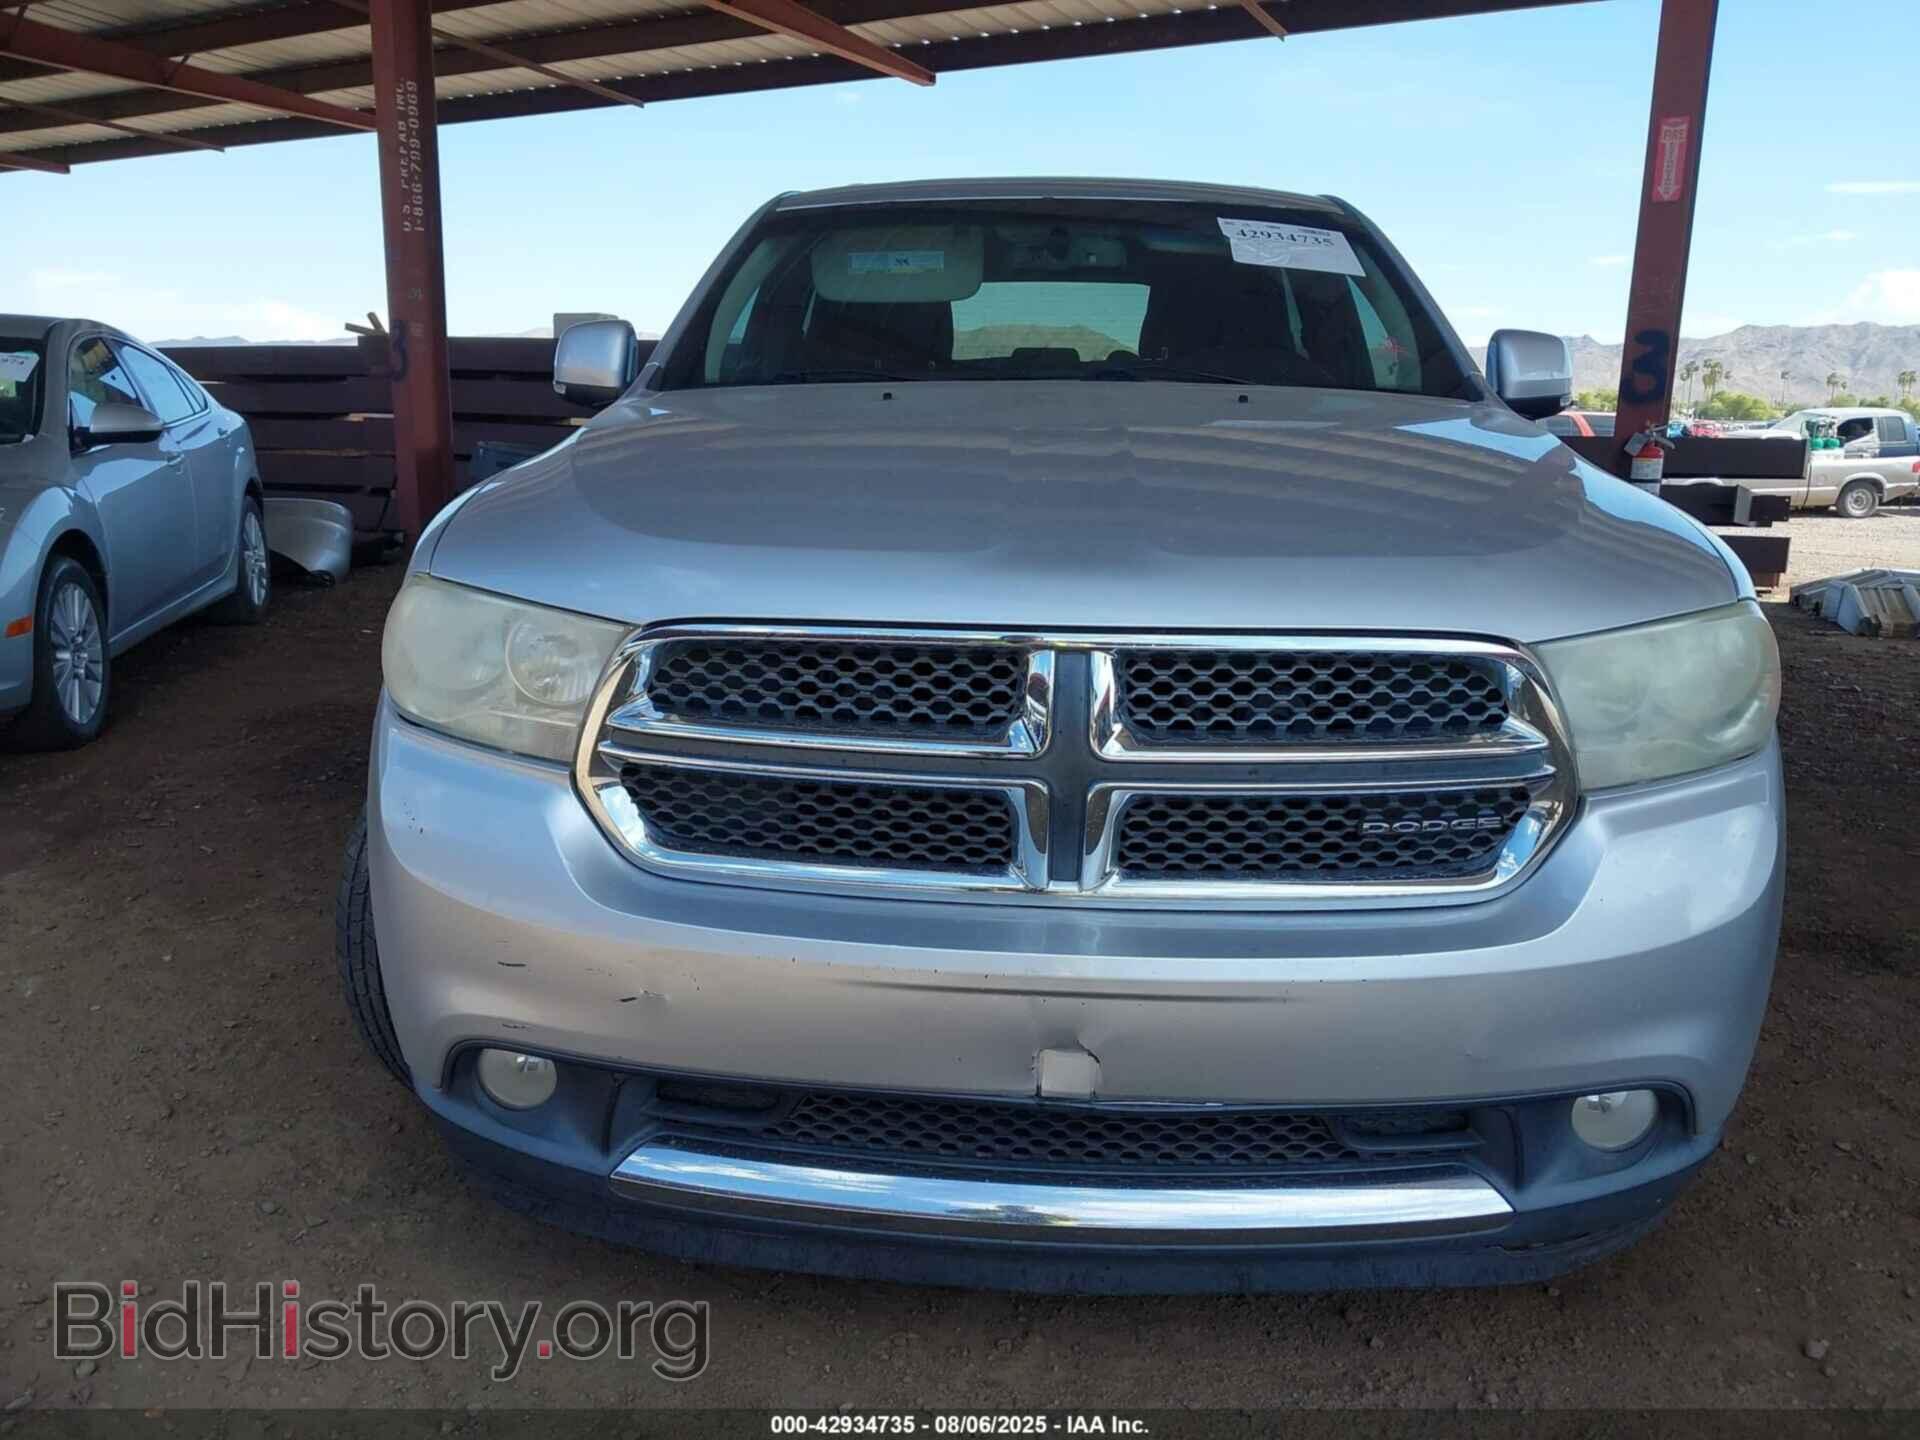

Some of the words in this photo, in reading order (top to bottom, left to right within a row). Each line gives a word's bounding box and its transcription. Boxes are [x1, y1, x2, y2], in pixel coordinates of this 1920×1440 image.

[405, 80, 424, 232] 1-866-799-0969
[1236, 228, 1335, 247] 42934735
[1362, 816, 1502, 833] DODGE
